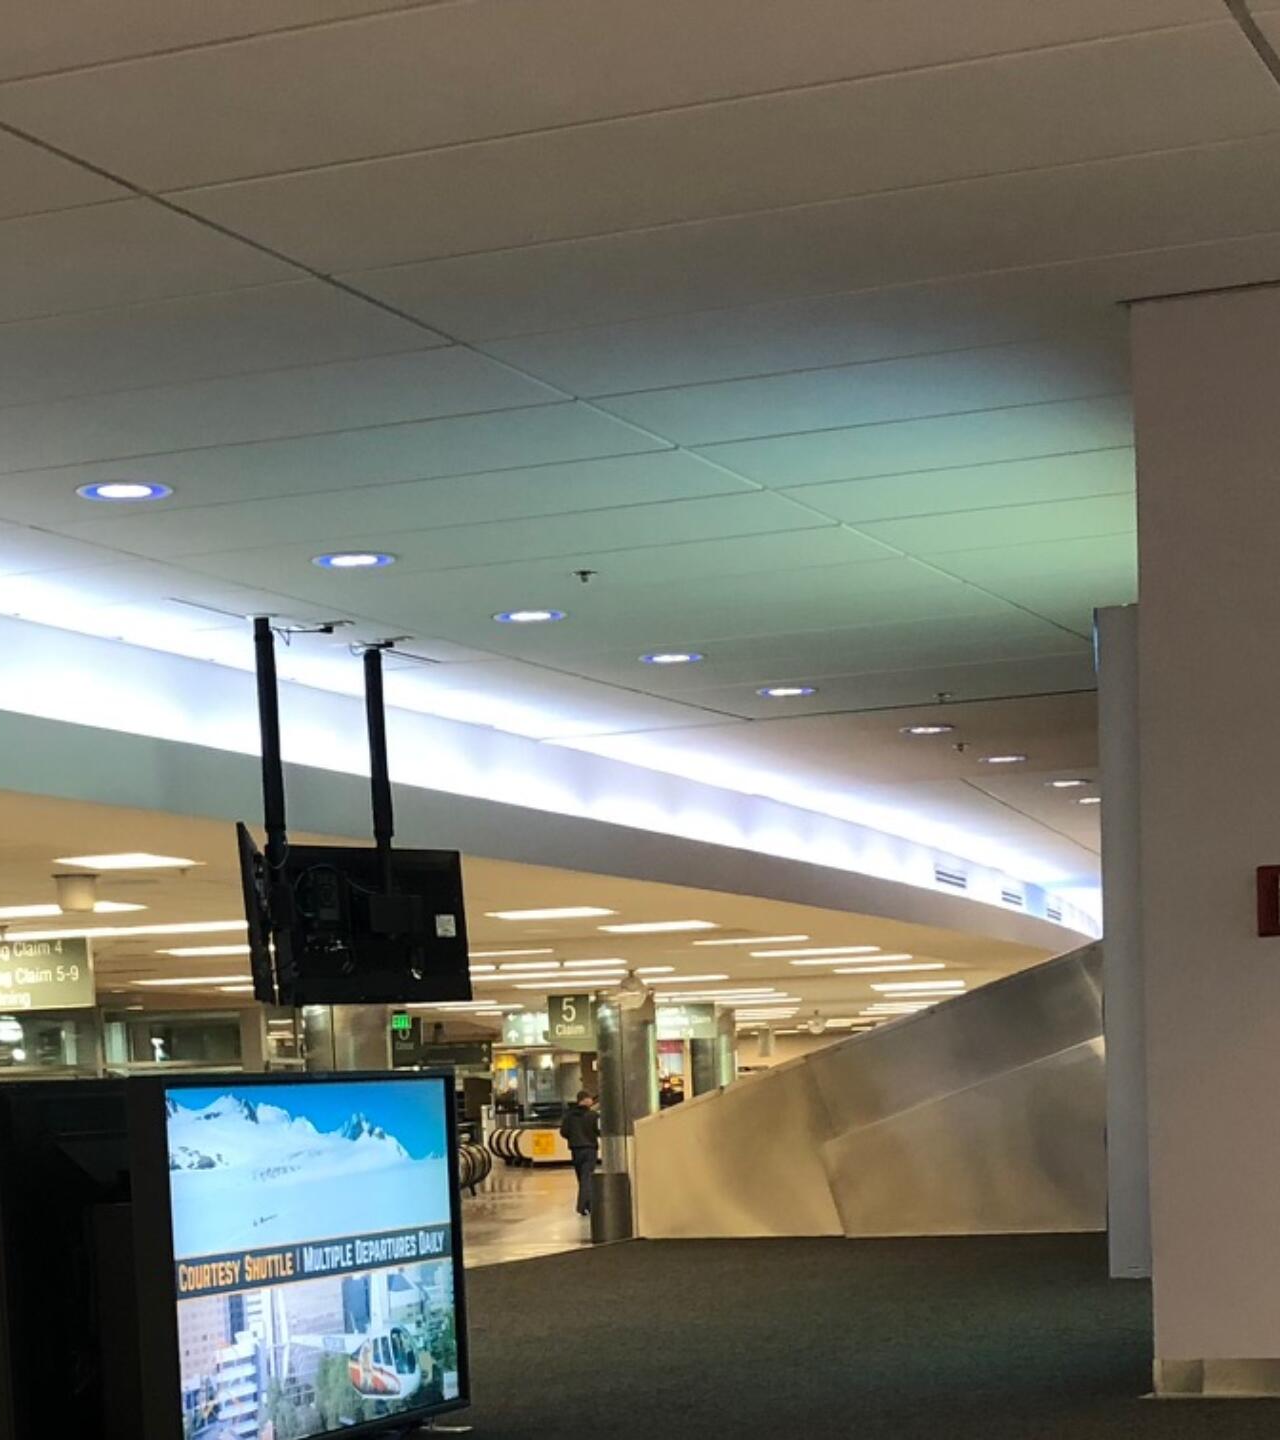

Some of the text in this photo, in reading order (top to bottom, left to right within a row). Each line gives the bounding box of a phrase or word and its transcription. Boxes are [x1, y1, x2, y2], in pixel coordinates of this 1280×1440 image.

[13, 941, 50, 957] Claim
[54, 940, 63, 954] 4
[15, 967, 52, 985] Claim
[56, 965, 80, 982] 5-9
[561, 997, 577, 1022] 5
[555, 1024, 585, 1036] Claim
[178, 1230, 445, 1293] COURTESY SHUTTLE MULTIPLE DEPARTURES DAILY
